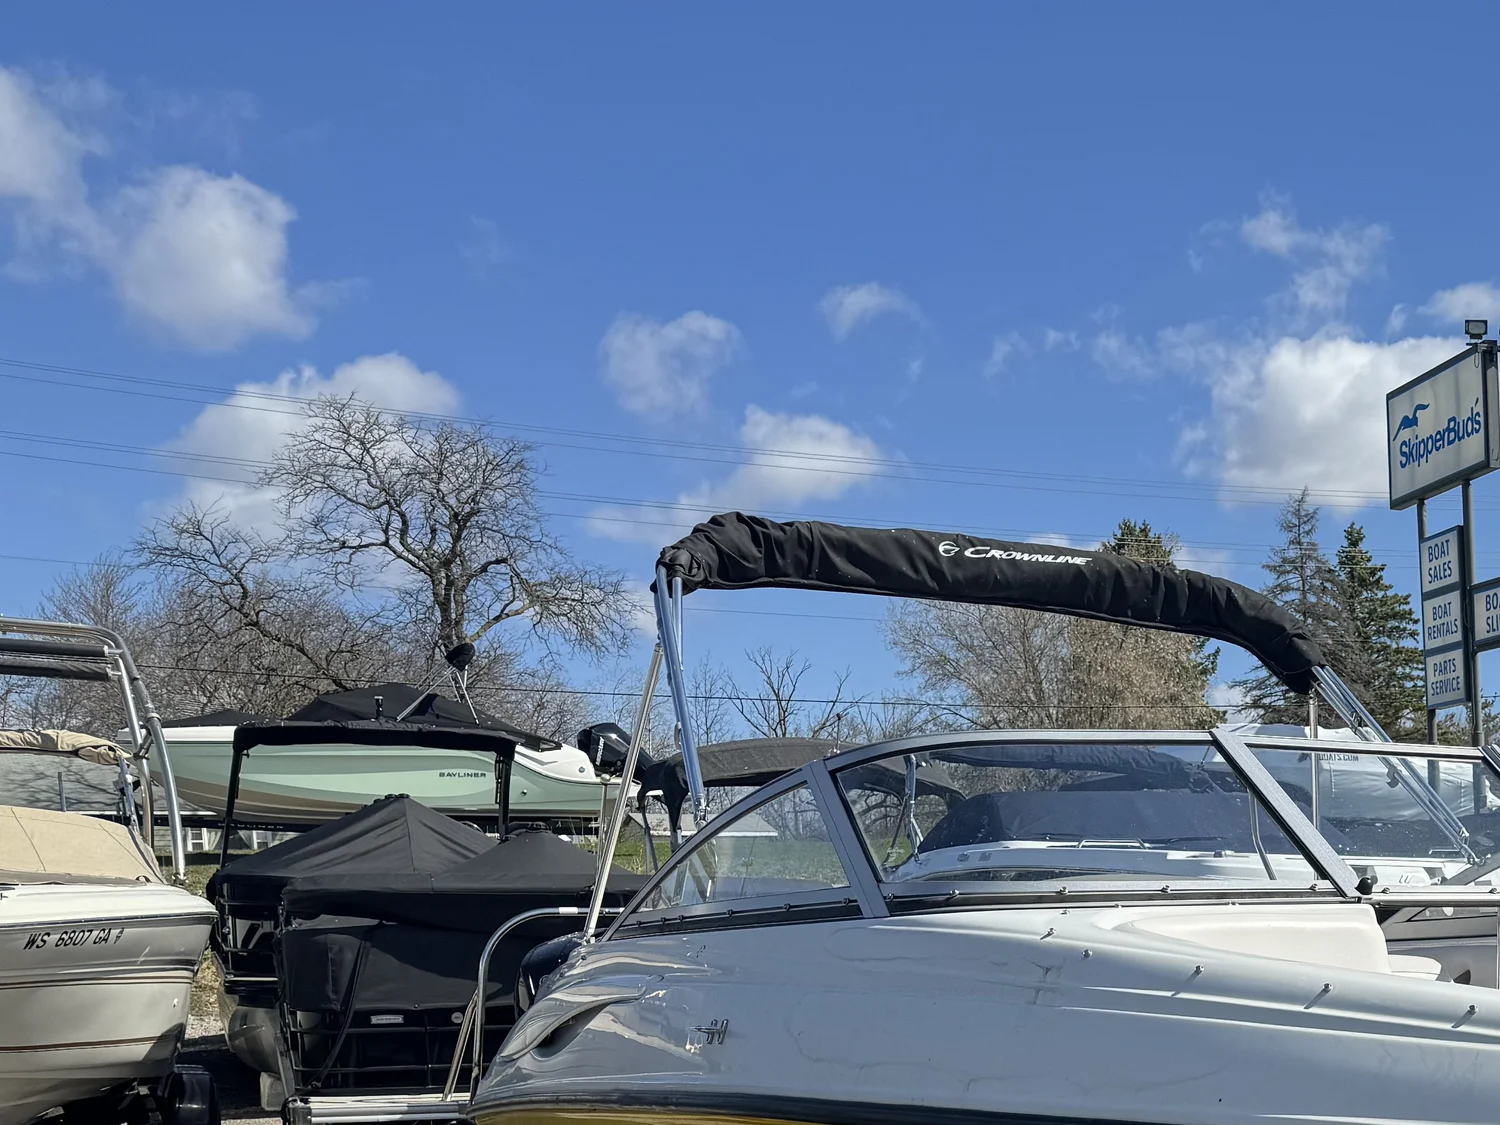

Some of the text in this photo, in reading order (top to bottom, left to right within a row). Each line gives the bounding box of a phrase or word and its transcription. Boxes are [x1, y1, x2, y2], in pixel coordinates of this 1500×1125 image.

[1399, 396, 1482, 469] SkipperBud's
[1427, 539, 1450, 563] BOAT
[1428, 560, 1453, 584] SALES
[1432, 601, 1452, 622] BOAT
[1427, 618, 1459, 641] RENTALS
[1433, 658, 1457, 678] PARTS
[1431, 676, 1461, 697] SERVICE
[438, 771, 487, 779] BAYLINER
[22, 927, 112, 950] WS 6807 GA
